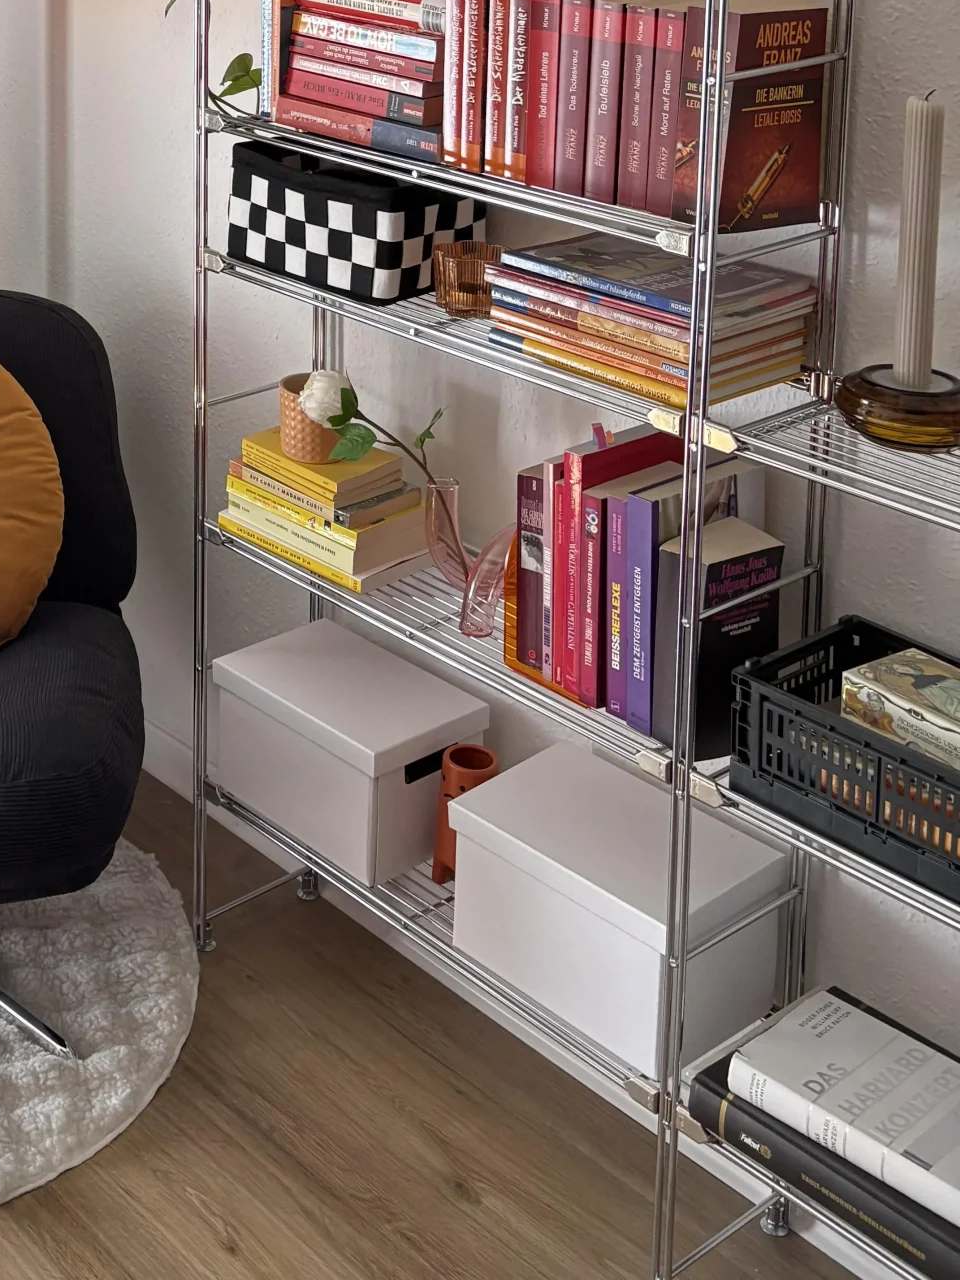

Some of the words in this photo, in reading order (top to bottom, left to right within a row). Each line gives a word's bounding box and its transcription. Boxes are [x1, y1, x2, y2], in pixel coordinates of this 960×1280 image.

[304, 18, 327, 38] GAY
[328, 24, 344, 41] BE
[346, 26, 366, 45] TO
[756, 20, 811, 48] ANDREAS
[367, 31, 395, 51] HOW
[492, 0, 505, 80] Scherbensammler
[512, 7, 527, 82] Mädchenmaler
[541, 52, 549, 80] Lehrers
[570, 49, 579, 93] Todeskreuz
[634, 54, 642, 88] Nachtigall
[303, 80, 327, 94] BUCH
[372, 74, 388, 86] FKC
[598, 60, 610, 116] Teufelsleib
[663, 70, 672, 95] Raten
[328, 87, 340, 97] Ein
[345, 91, 367, 103] FRAU
[367, 96, 384, 107] Eine
[466, 93, 475, 103] Der
[491, 83, 501, 102] Der
[512, 86, 523, 105] Der
[540, 83, 548, 102] eines
[755, 88, 767, 103] DIE
[769, 85, 804, 101] BANKERIN
[539, 104, 547, 119] Tod
[569, 95, 577, 110] Das
[661, 96, 670, 111] auf
[660, 113, 669, 136] Mord
[754, 111, 779, 128] LETALE
[780, 109, 802, 124] DOSIS
[420, 140, 434, 151] UTB
[568, 128, 578, 160] FRANZ
[597, 135, 607, 167] FRANZ
[631, 141, 641, 173] FRANZ
[658, 147, 669, 180] FRANZ
[582, 276, 599, 289] Reiten
[599, 282, 610, 292] auf
[609, 285, 647, 302] Islandpferden
[670, 302, 691, 313] KOSMO
[662, 362, 685, 375] KOSMOS
[647, 371, 656, 380] Die
[656, 373, 687, 389] Reitschule
[644, 387, 671, 402] wusste
[280, 548, 289, 556] MIT
[290, 553, 301, 562] MAN
[301, 558, 311, 566] WIE
[569, 543, 577, 575] WORLDS
[721, 563, 746, 579] Hans
[747, 556, 767, 571] Joas
[708, 576, 750, 597] Wolfgang
[751, 566, 777, 586] Knöbl
[585, 618, 593, 642] GEORGE
[611, 582, 620, 670] BEISSREFLEXE
[799, 1012, 818, 1027] ROGER
[816, 1001, 834, 1016] FISHER
[811, 1014, 832, 1030] WILLIAM
[831, 1005, 842, 1017] URY
[815, 1023, 833, 1038] BRUCE
[832, 1011, 851, 1026] PATTON
[803, 1063, 849, 1095] DAS
[837, 1048, 928, 1117] HARVARD
[740, 1131, 761, 1153] Fallout
